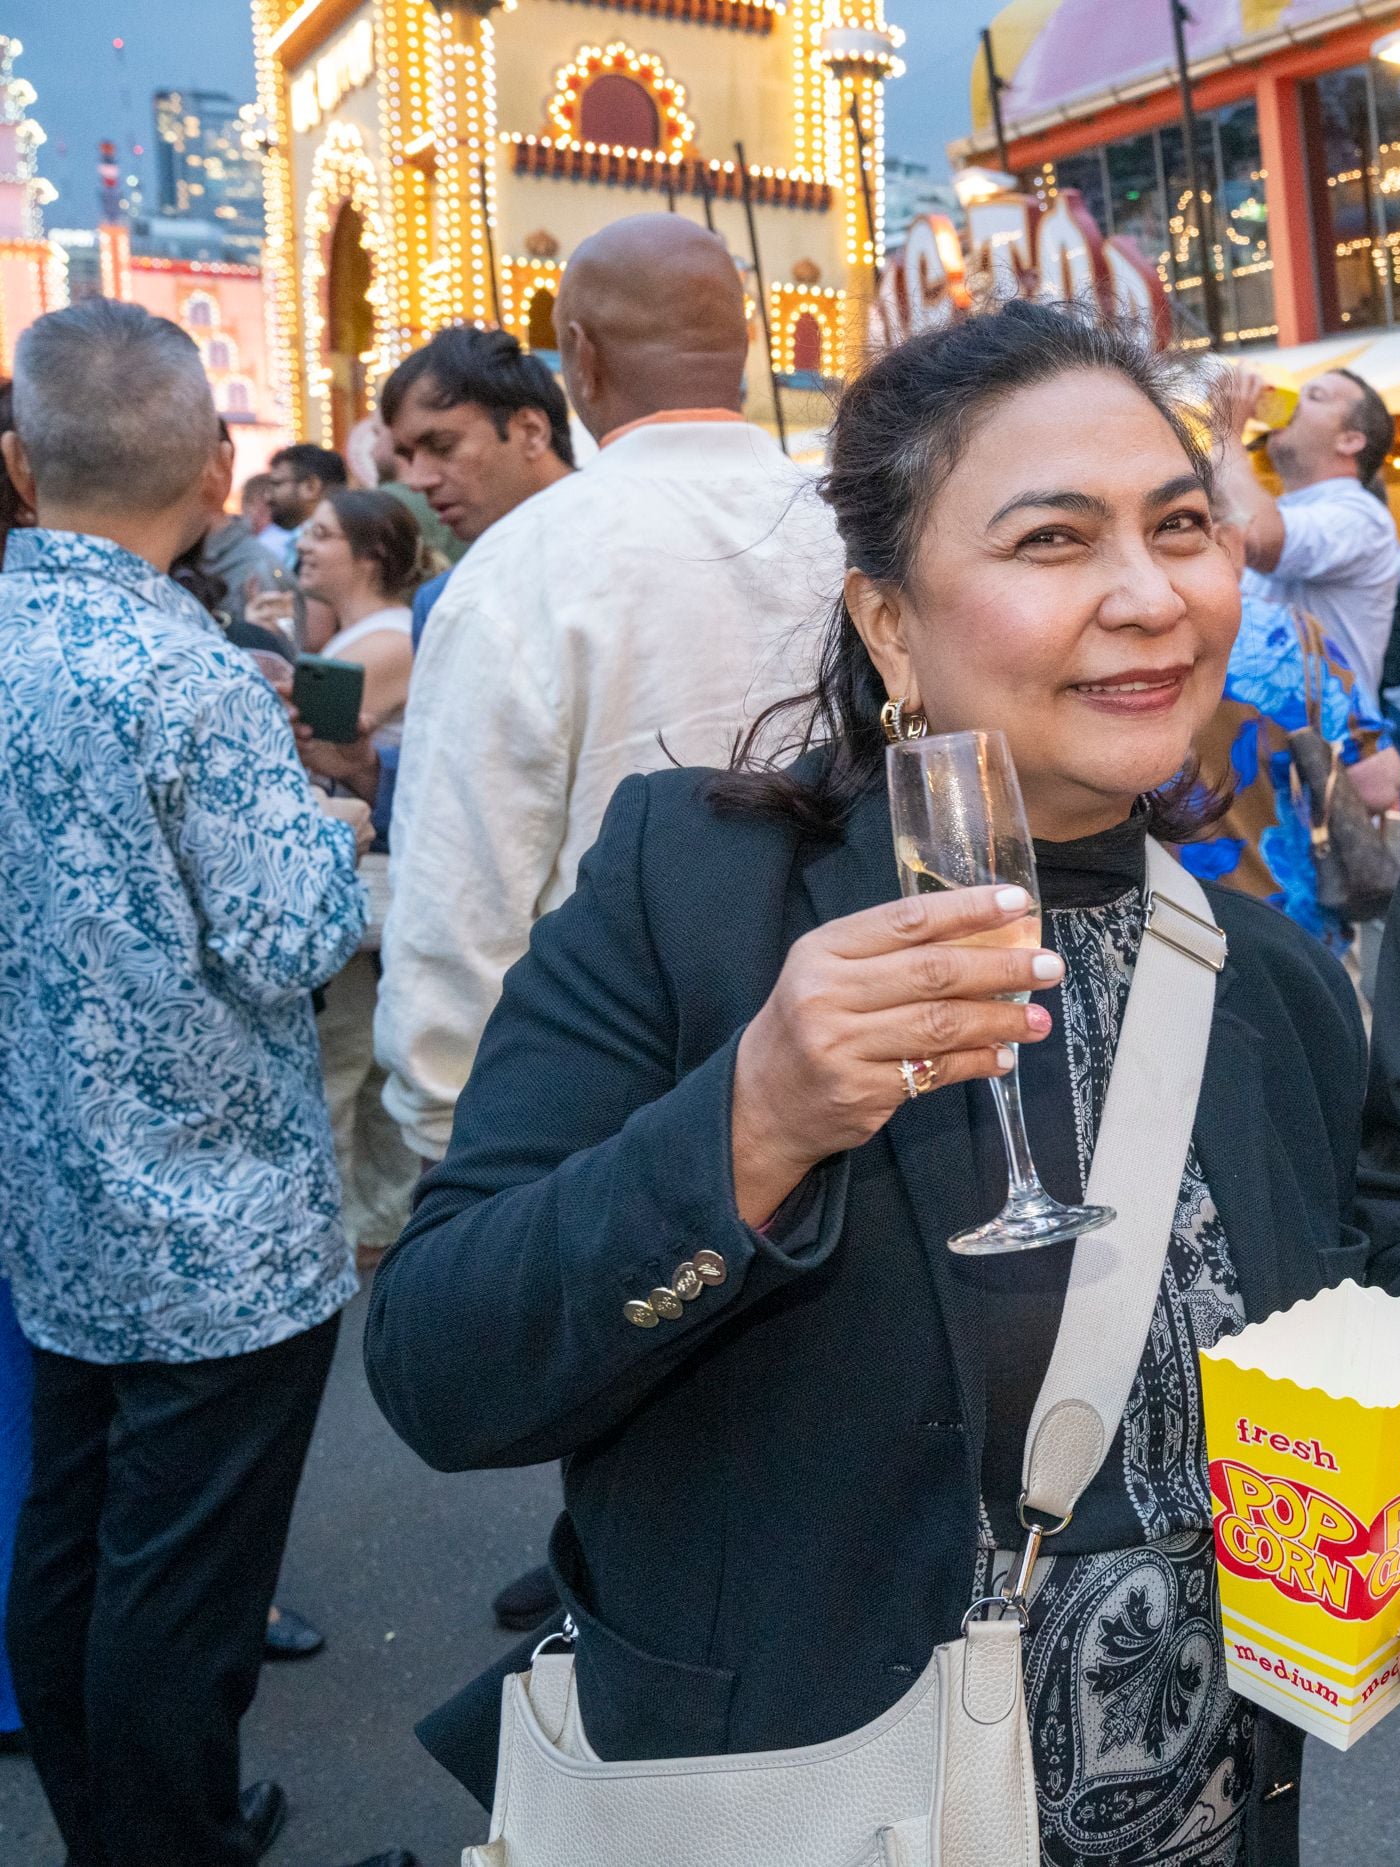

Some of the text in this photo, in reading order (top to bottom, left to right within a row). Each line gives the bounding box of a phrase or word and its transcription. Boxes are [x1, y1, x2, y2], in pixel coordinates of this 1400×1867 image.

[1236, 1418, 1339, 1472] fresh
[1222, 1463, 1357, 1551] POP
[1219, 1514, 1352, 1613] CORN
[1234, 1644, 1340, 1707] medium
